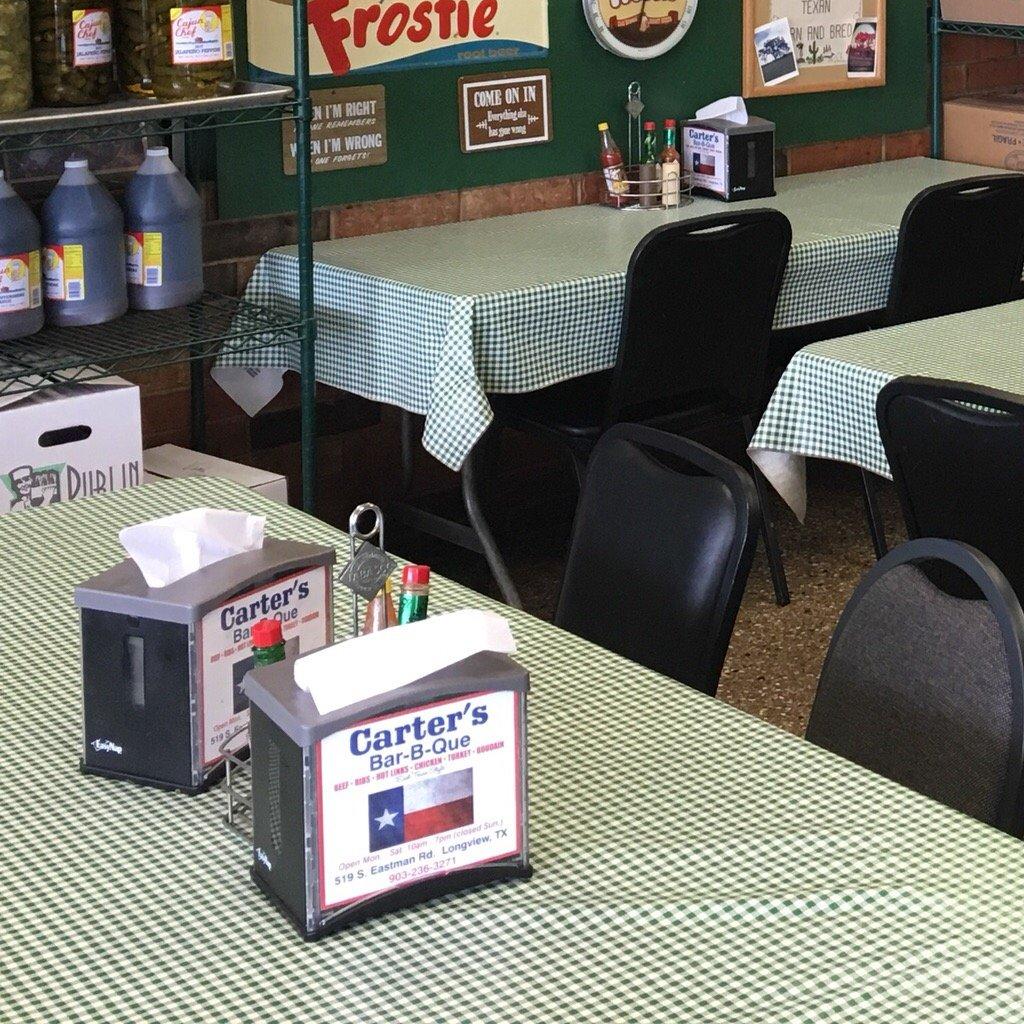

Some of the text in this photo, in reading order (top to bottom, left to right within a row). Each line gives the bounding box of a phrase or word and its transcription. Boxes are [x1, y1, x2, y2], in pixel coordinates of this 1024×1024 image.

[801, 0, 831, 14] TEXAN
[175, 26, 197, 38] Chef
[807, 26, 825, 40] AND
[474, 86, 536, 107] COME ON IN
[326, 102, 342, 120] I'M
[345, 100, 377, 118] RIGHT
[487, 108, 527, 122] Everything else
[326, 118, 376, 130] REMEMBERS
[489, 125, 526, 137] has gone wrong
[324, 133, 383, 154] I'M WRONG
[689, 129, 719, 143] Carter's
[315, 157, 330, 165] ONE
[221, 580, 310, 631] Carter's
[211, 732, 224, 745] 519
[350, 703, 489, 757] Carter's
[369, 734, 471, 771] Bar-B-Que
[334, 782, 349, 792] BEEF
[355, 776, 371, 787] RIBS
[376, 772, 389, 782] HOT
[390, 765, 409, 778] LINKS
[415, 757, 443, 771] CHICKEN
[448, 749, 471, 763] TURKEY
[334, 828, 508, 886] 519 S. Eastman Rd. Longview, TX
[338, 860, 360, 872] Open
[362, 854, 380, 864] Mon
[390, 846, 402, 857] Sat
[435, 833, 452, 845] 7pm
[389, 856, 457, 884] 903-236-3271
